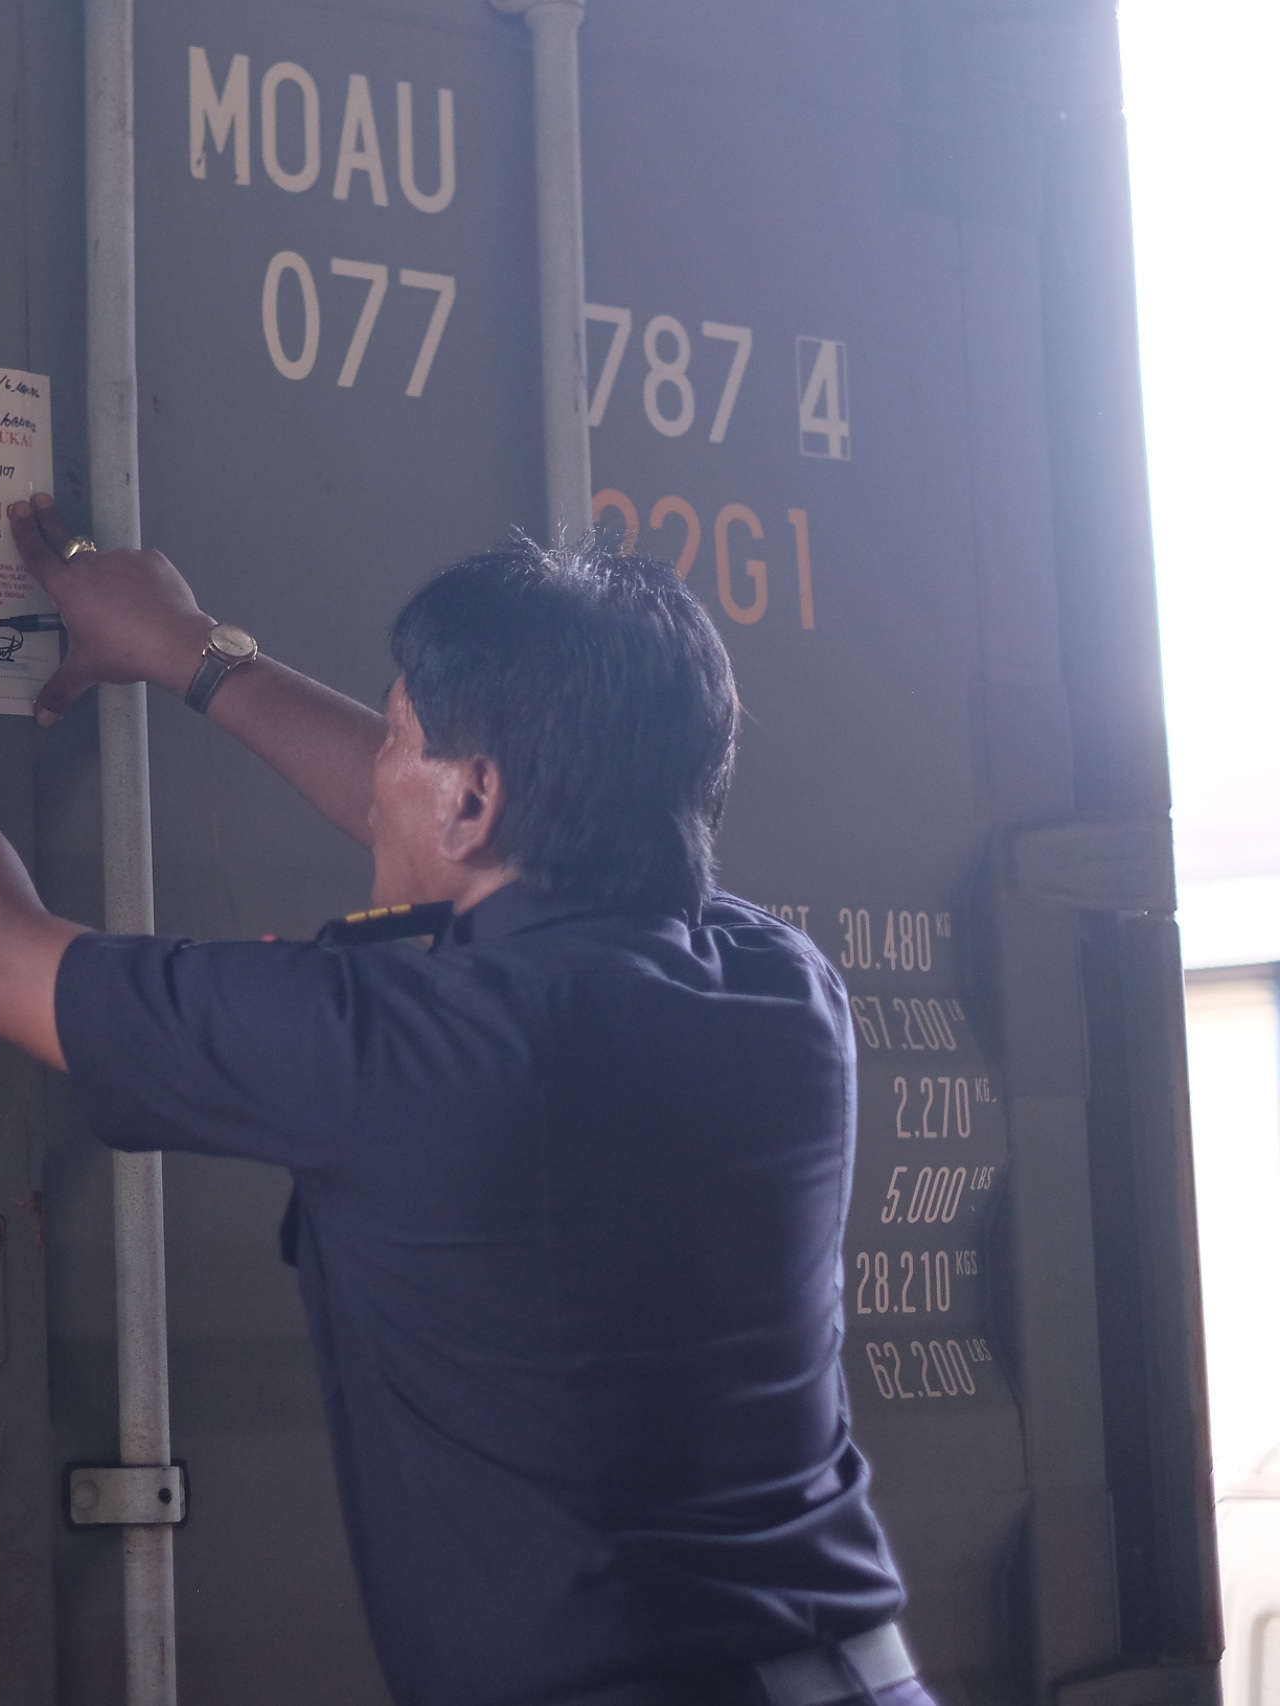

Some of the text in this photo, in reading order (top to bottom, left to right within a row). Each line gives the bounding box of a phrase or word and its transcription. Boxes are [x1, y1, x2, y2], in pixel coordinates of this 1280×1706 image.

[188, 45, 455, 213] MOAU
[261, 250, 850, 460] 077 787 4
[839, 907, 932, 972] 30.480
[935, 912, 951, 938] KG
[850, 995, 957, 1052] 67.200
[893, 1076, 971, 1139] 2.270
[880, 1166, 995, 1224] 5.000 LBS
[856, 1250, 978, 1315] 28.210 KGS
[865, 1338, 976, 1401] 62.200
